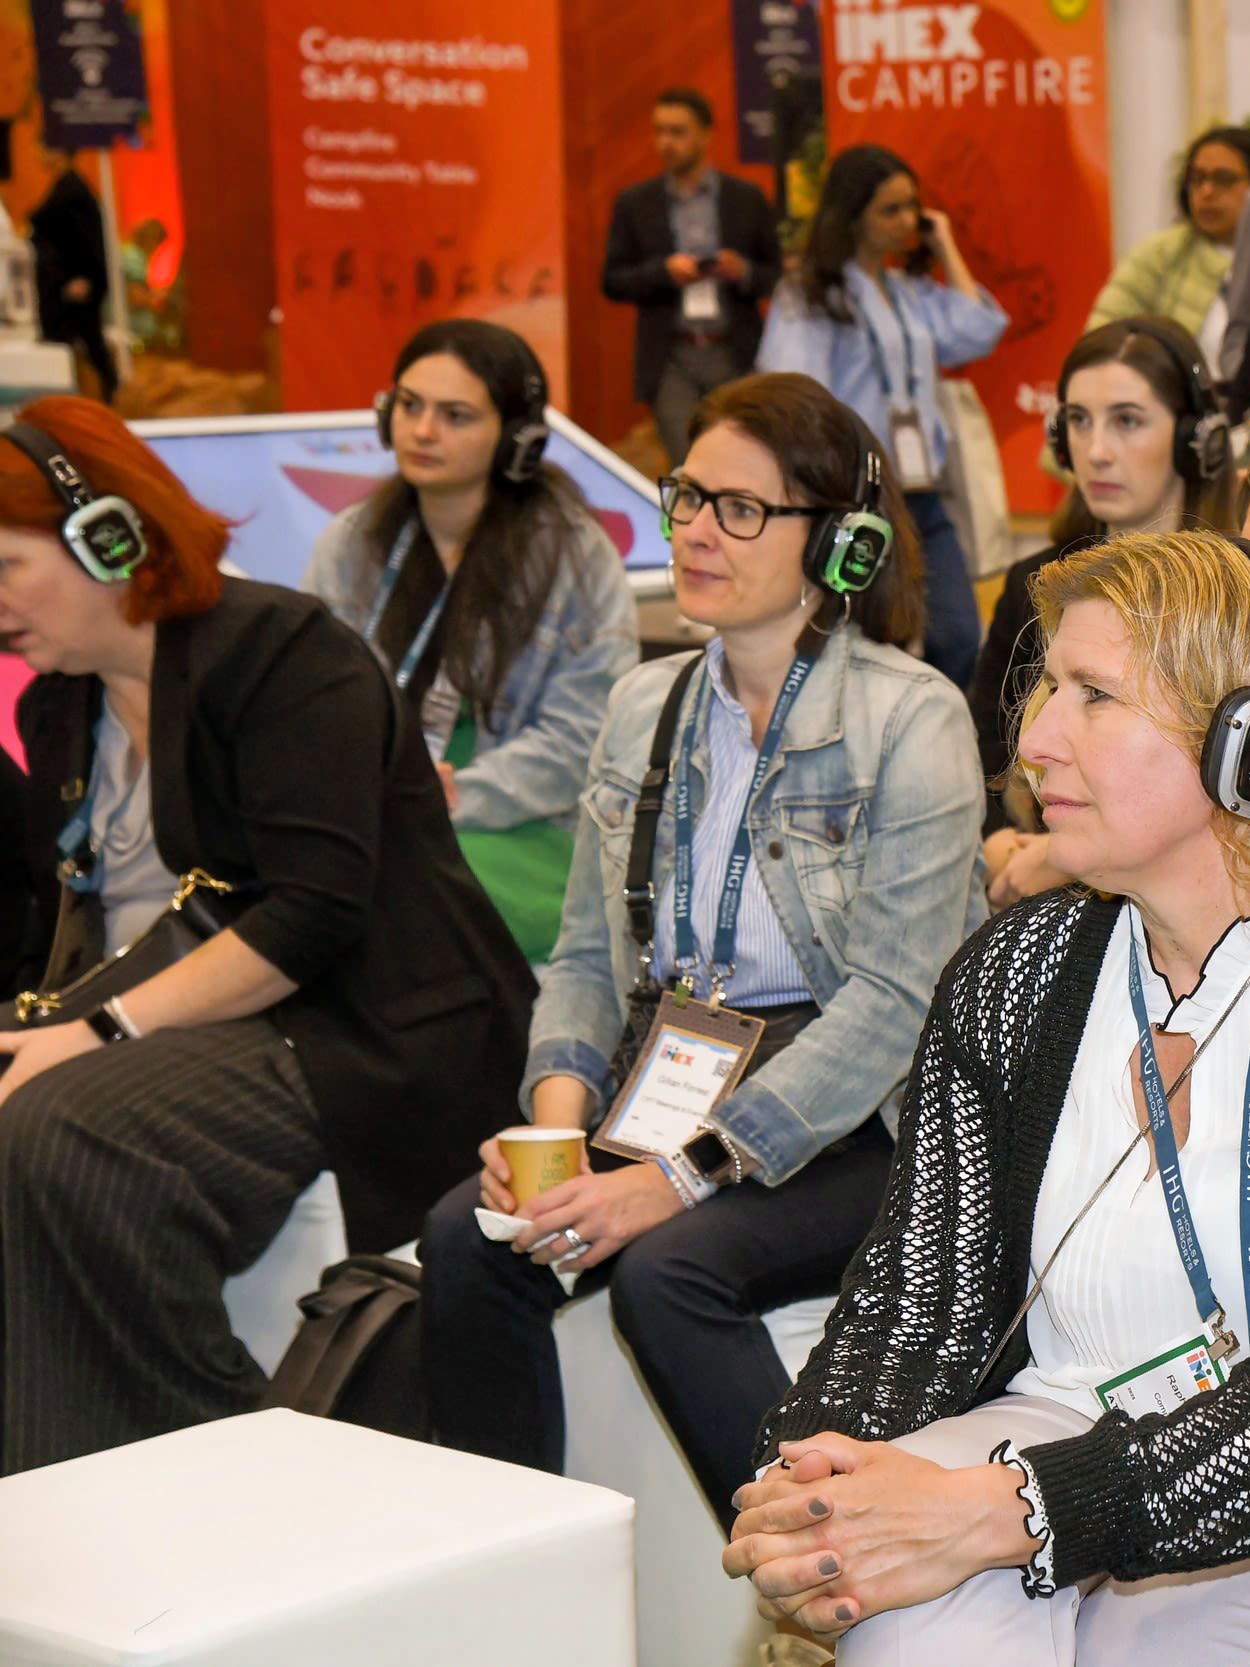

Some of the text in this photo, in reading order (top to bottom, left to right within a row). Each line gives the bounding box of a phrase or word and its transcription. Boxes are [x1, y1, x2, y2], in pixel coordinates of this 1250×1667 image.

[300, 27, 528, 70] Conversation
[836, 5, 983, 64] IMEX
[302, 65, 485, 111] Safe Space
[837, 56, 1094, 112] CAMPFIRE
[785, 661, 808, 692] IHG
[677, 785, 688, 820] IHG
[727, 855, 746, 889] IHG
[676, 884, 688, 918] IHG
[1140, 1028, 1157, 1074] IHG
[1144, 1080, 1160, 1131] RESORTS
[1152, 1076, 1165, 1118] HOTELS
[1162, 1164, 1185, 1214] IHG
[1176, 1218, 1193, 1271] RESORTS
[1182, 1214, 1197, 1258] HOTELS
[1154, 1392, 1168, 1417] Com
